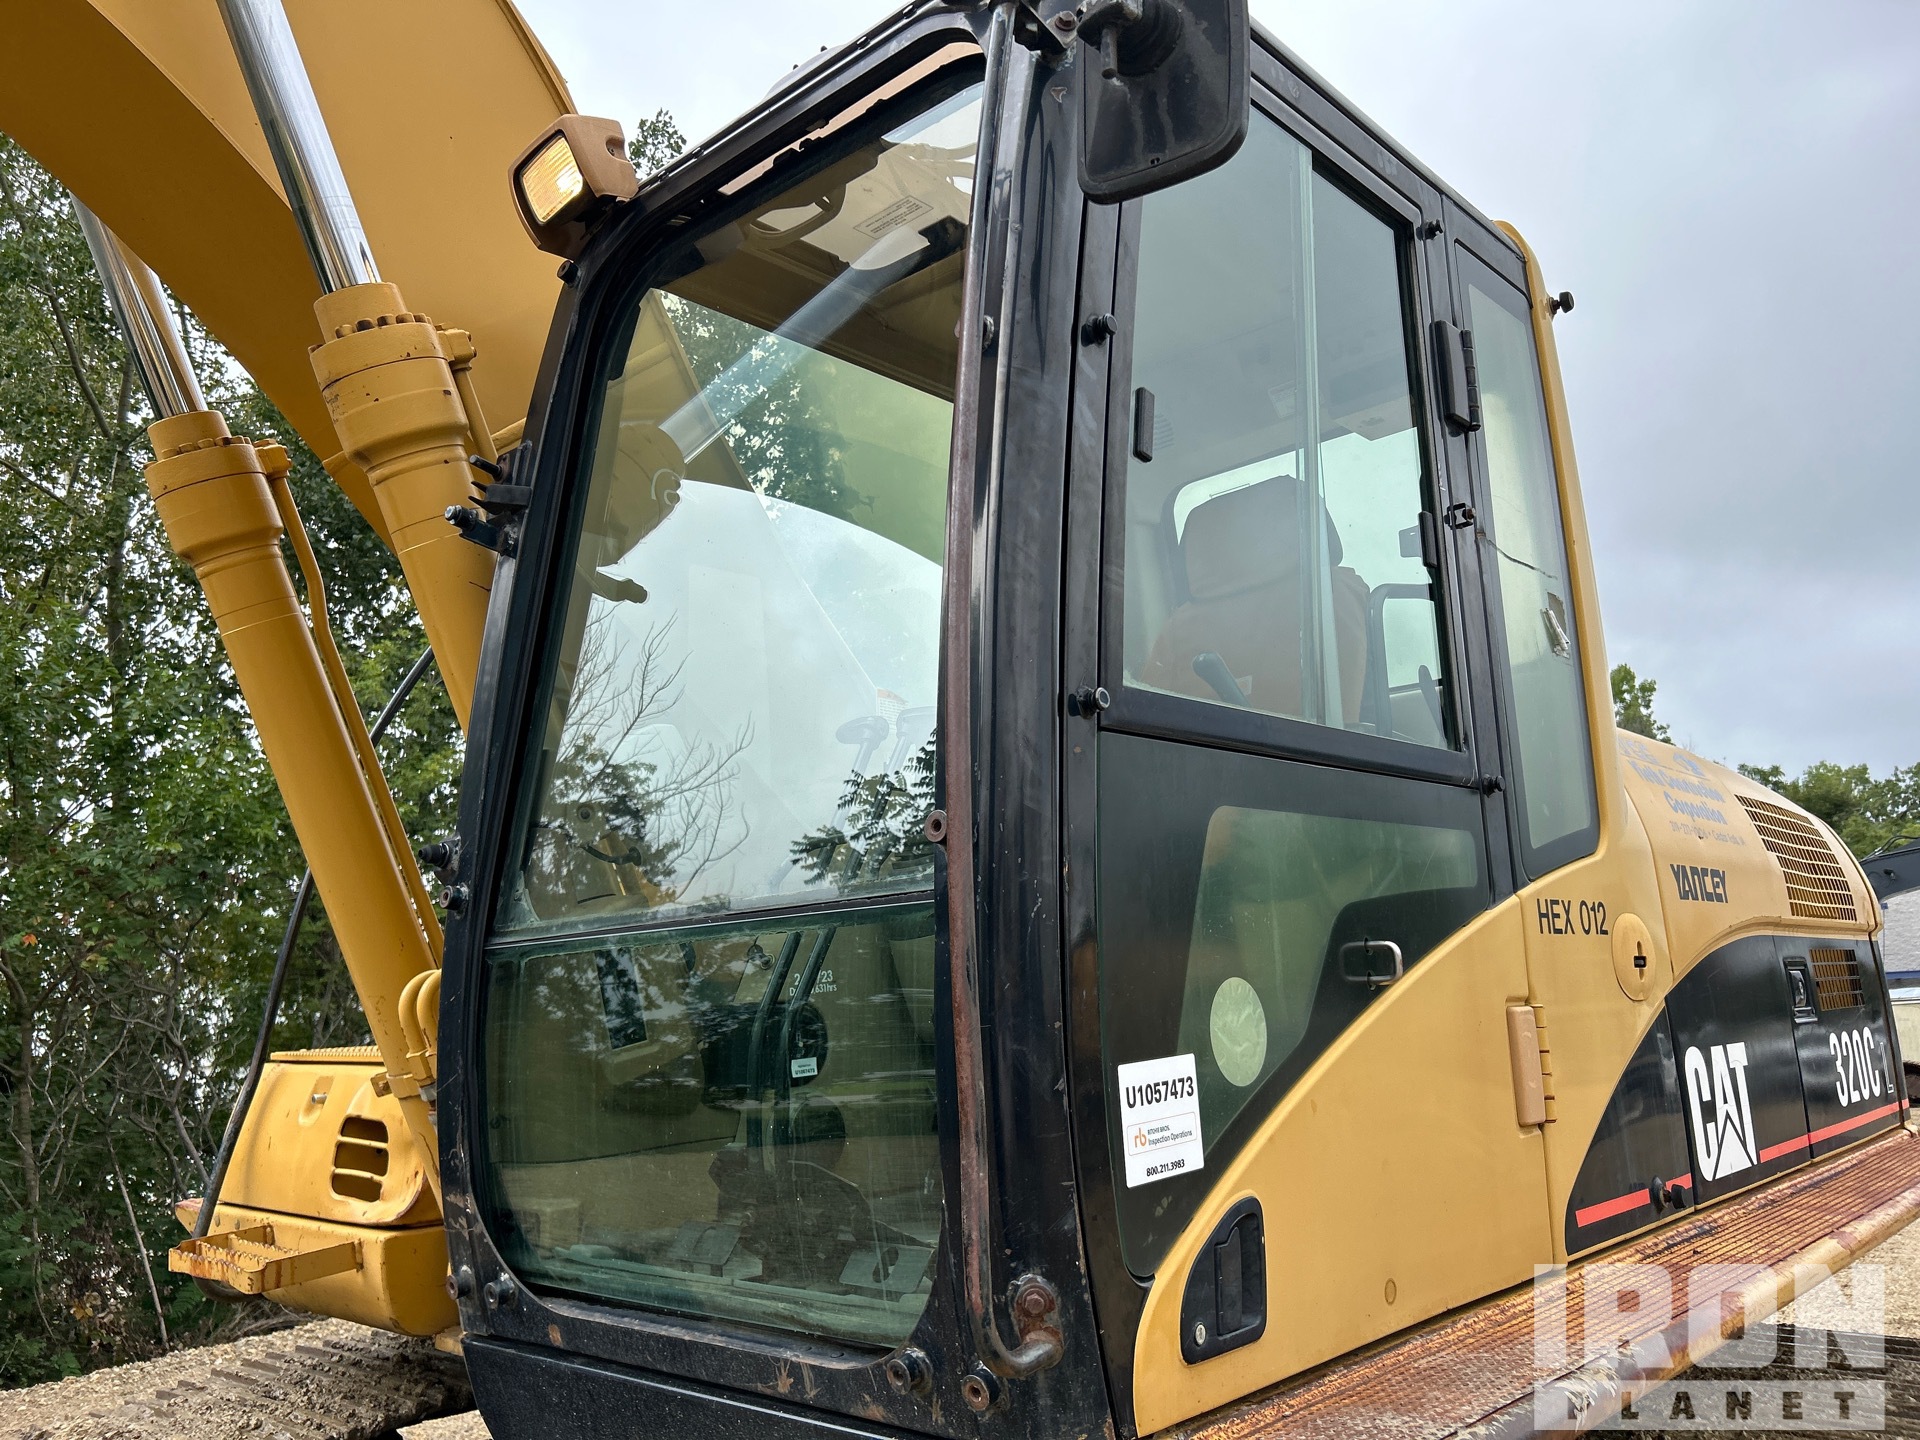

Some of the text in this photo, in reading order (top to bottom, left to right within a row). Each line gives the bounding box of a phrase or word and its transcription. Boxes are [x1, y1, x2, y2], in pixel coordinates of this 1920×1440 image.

[1670, 863, 1729, 904] YANCEY
[1536, 898, 1609, 936] HEX 012
[1829, 1026, 1895, 1107] 320C L
[1125, 1076, 1194, 1109] U1057473
[1684, 1041, 1757, 1182] CAT
[1148, 1130, 1193, 1147] Inspection Operations
[1146, 1158, 1185, 1177] 800.211.3983
